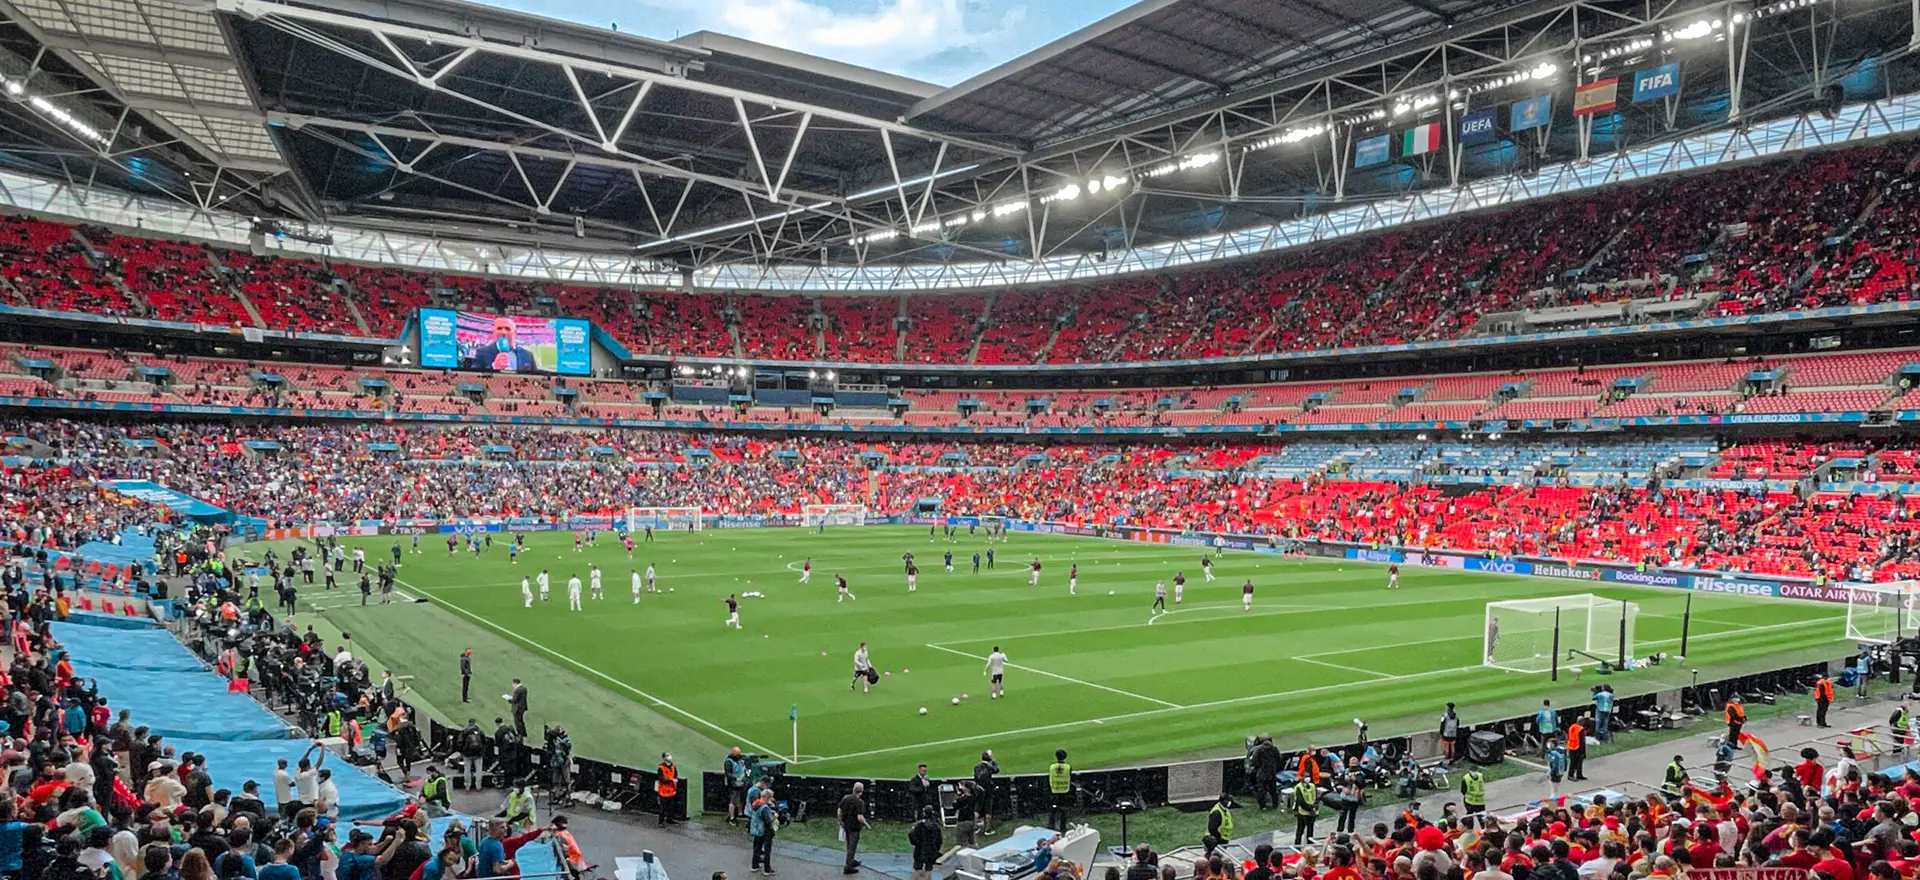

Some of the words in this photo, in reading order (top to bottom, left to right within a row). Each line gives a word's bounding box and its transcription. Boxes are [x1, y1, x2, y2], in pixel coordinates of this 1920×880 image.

[1639, 73, 1673, 92] FIFA
[1462, 119, 1492, 134] UEFA
[1731, 415, 1752, 423] UEFA
[1753, 415, 1777, 423] EURO
[1778, 414, 1800, 422] 2020
[1479, 560, 1515, 572] vivo
[1616, 571, 1677, 585] Booking.com
[1694, 577, 1772, 595] Hisense
[1780, 585, 1822, 598] QATAR
